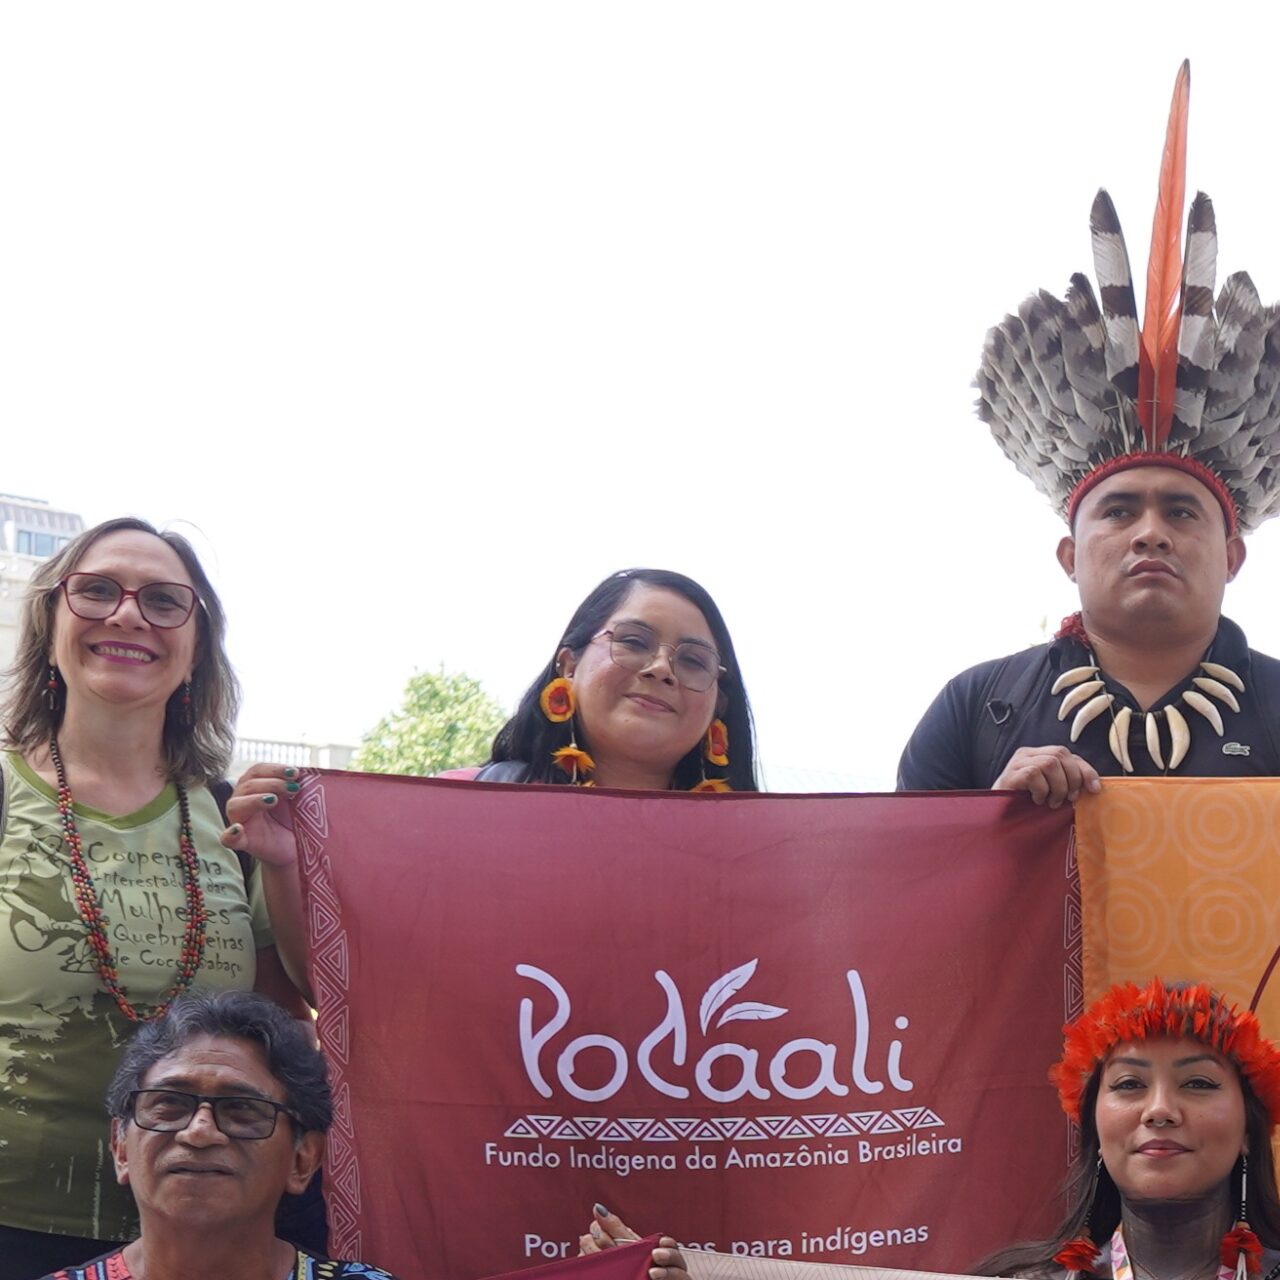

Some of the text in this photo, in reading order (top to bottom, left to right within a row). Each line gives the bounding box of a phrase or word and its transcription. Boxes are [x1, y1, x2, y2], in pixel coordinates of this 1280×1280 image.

[100, 888, 230, 924] Mulhees
[485, 1135, 962, 1176] Fundo Indígena da Amazônia Brasileira
[524, 1234, 570, 1258] Por
[732, 1239, 793, 1258] para
[801, 1224, 929, 1255] indígenas
